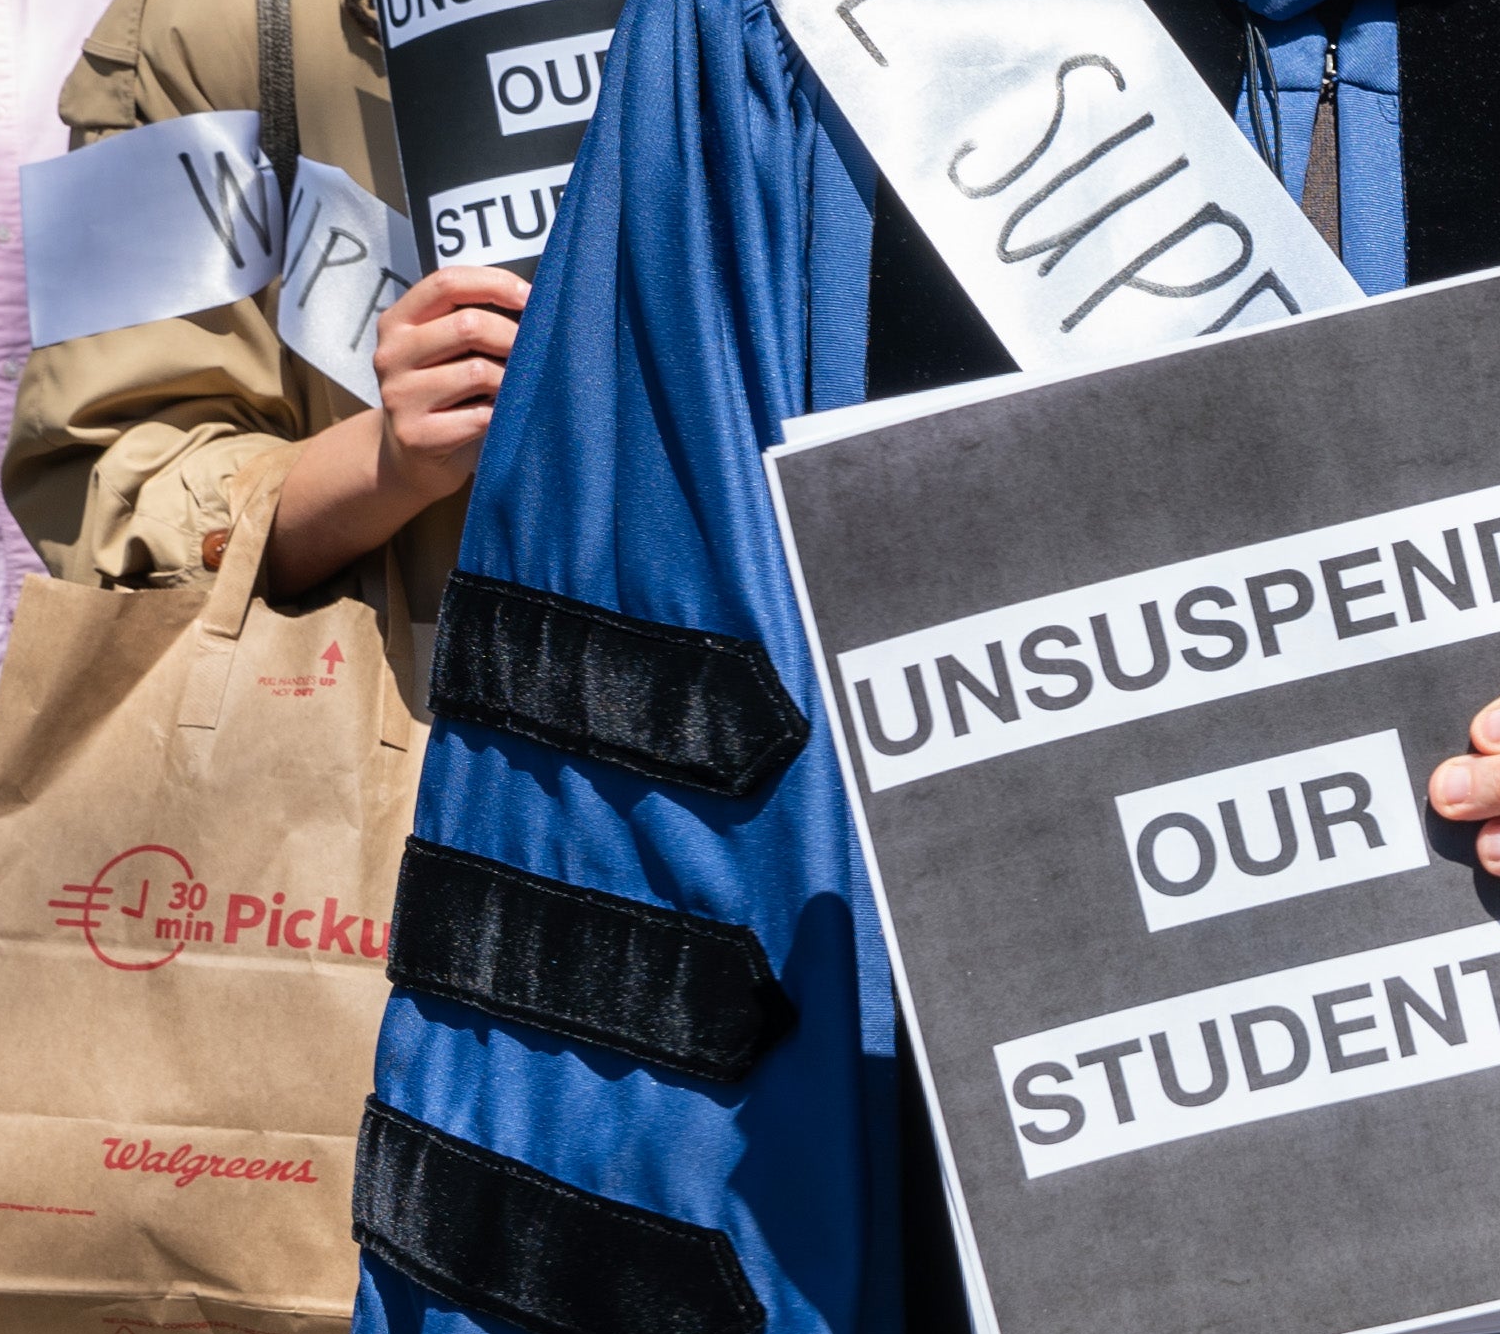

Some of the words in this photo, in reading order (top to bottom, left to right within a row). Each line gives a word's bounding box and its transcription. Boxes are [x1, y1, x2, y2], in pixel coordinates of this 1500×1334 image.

[435, 182, 566, 258] STU
[319, 677, 337, 687] UP
[1135, 771, 1387, 898] OUR
[167, 881, 208, 911] 30
[155, 912, 214, 943] min
[102, 1137, 319, 1188] Walgreens
